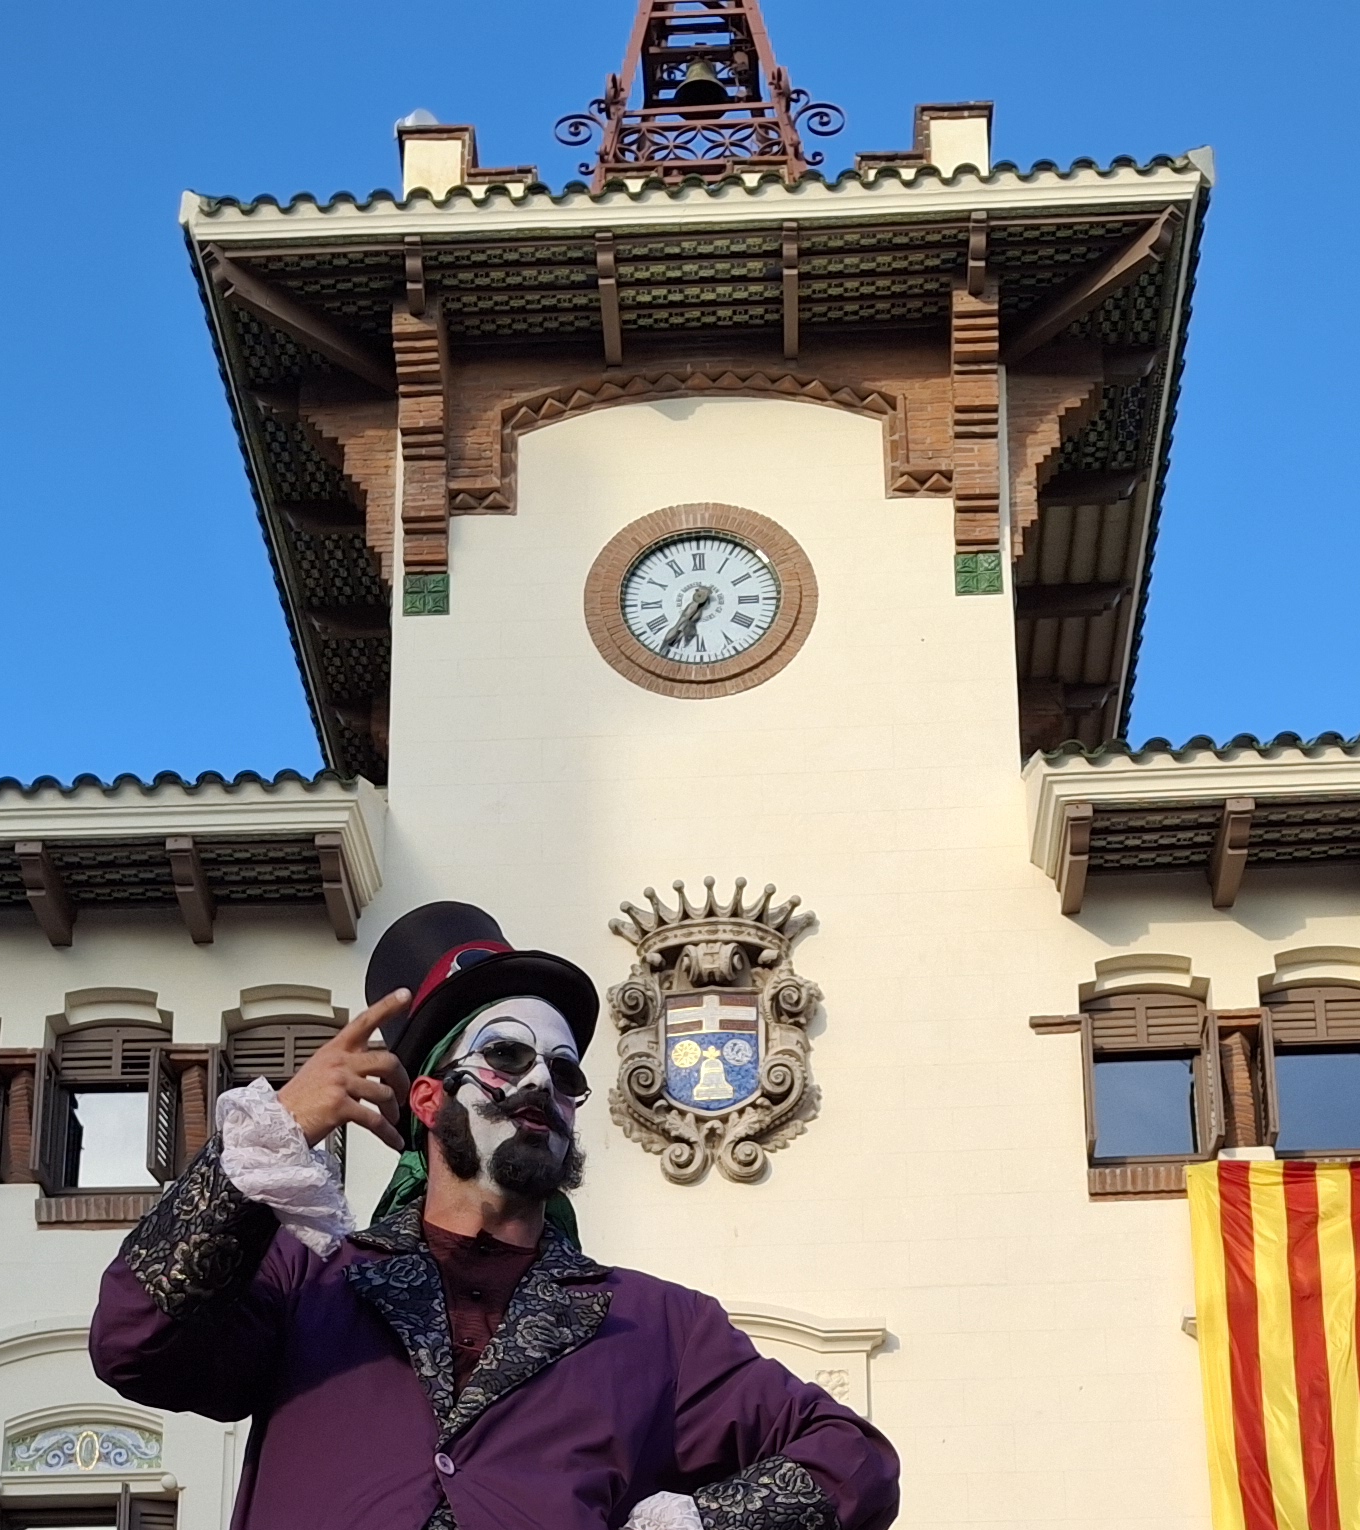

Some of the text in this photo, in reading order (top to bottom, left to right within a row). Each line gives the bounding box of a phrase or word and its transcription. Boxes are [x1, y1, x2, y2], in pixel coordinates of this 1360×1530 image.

[691, 553, 706, 571] XII
[731, 572, 752, 587] II
[738, 594, 759, 605] III
